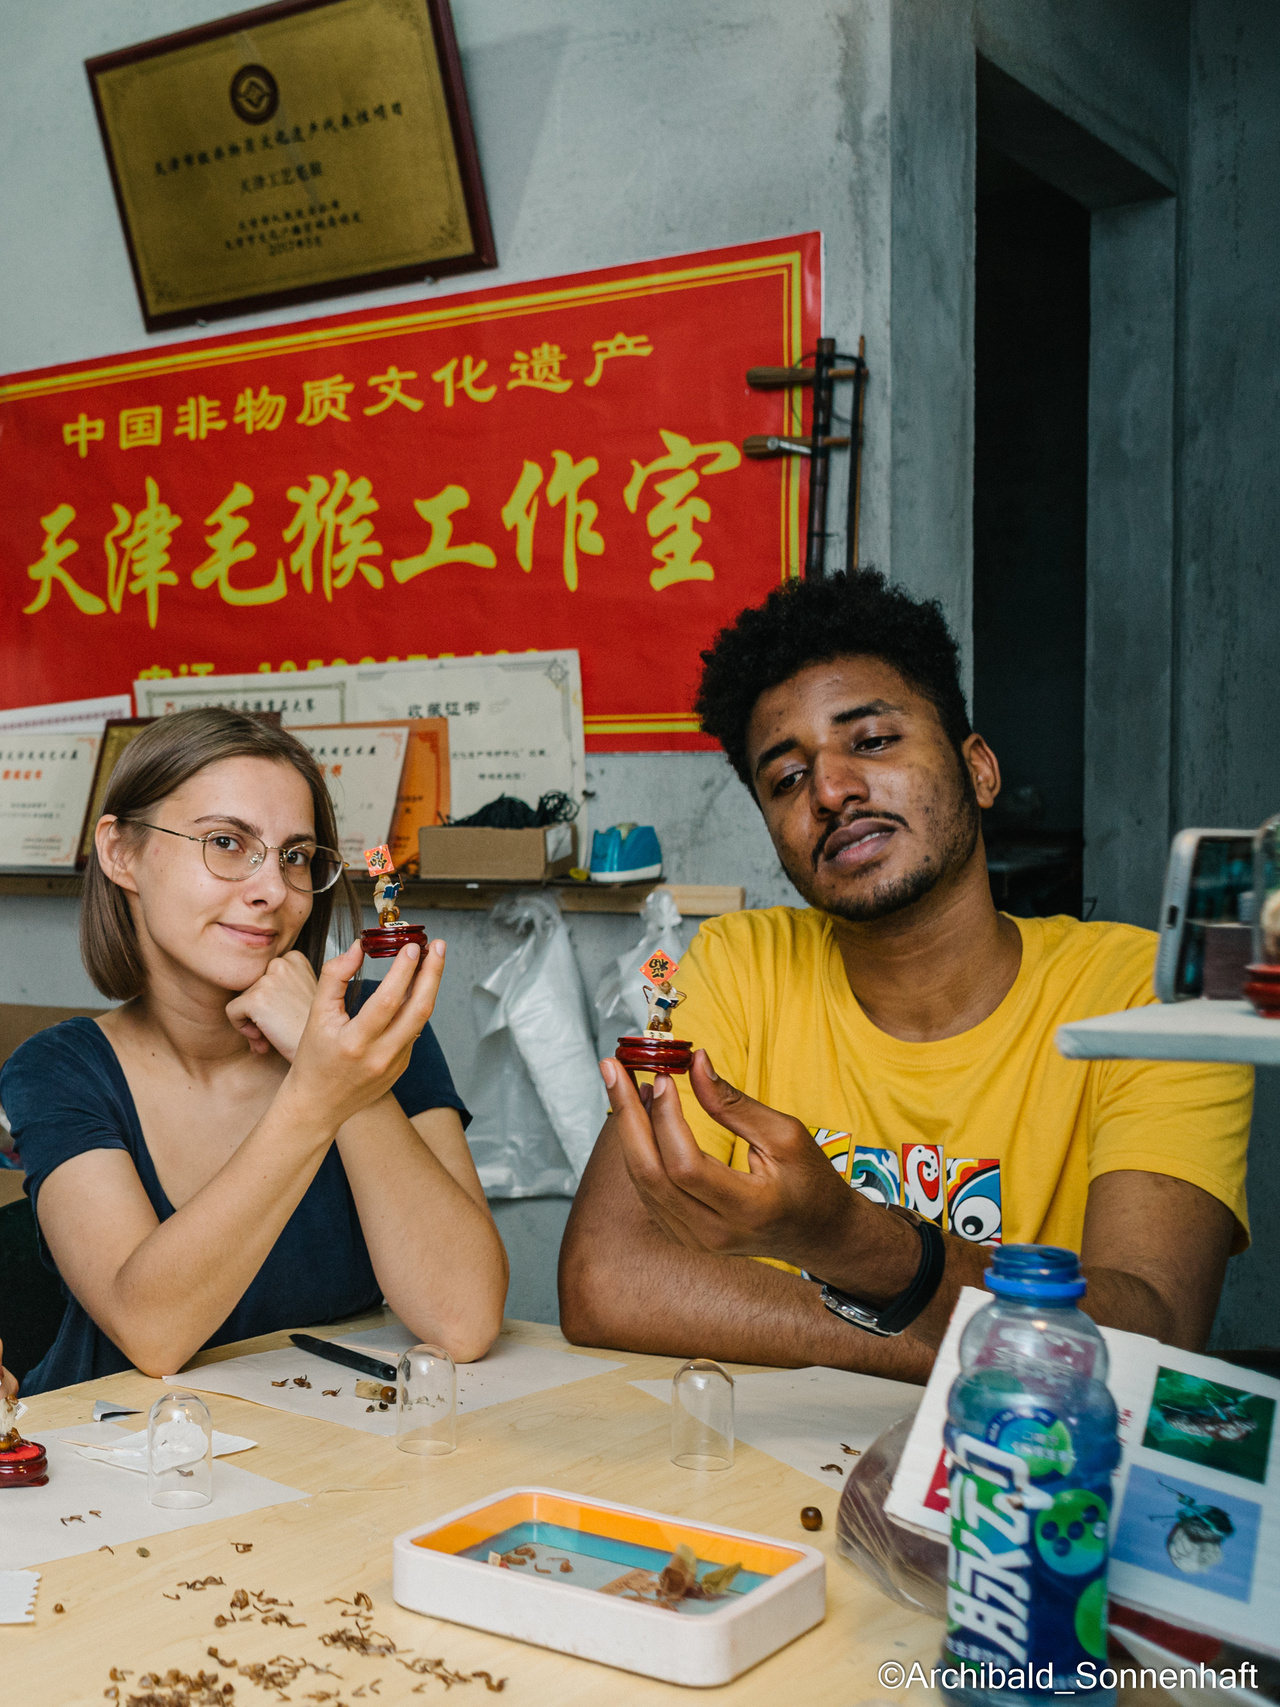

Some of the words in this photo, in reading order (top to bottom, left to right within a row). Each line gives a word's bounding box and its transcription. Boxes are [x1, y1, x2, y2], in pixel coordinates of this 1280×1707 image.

[62, 331, 655, 459] 中国非物质文化遗产
[23, 429, 742, 630] 天津毛猴工作室
